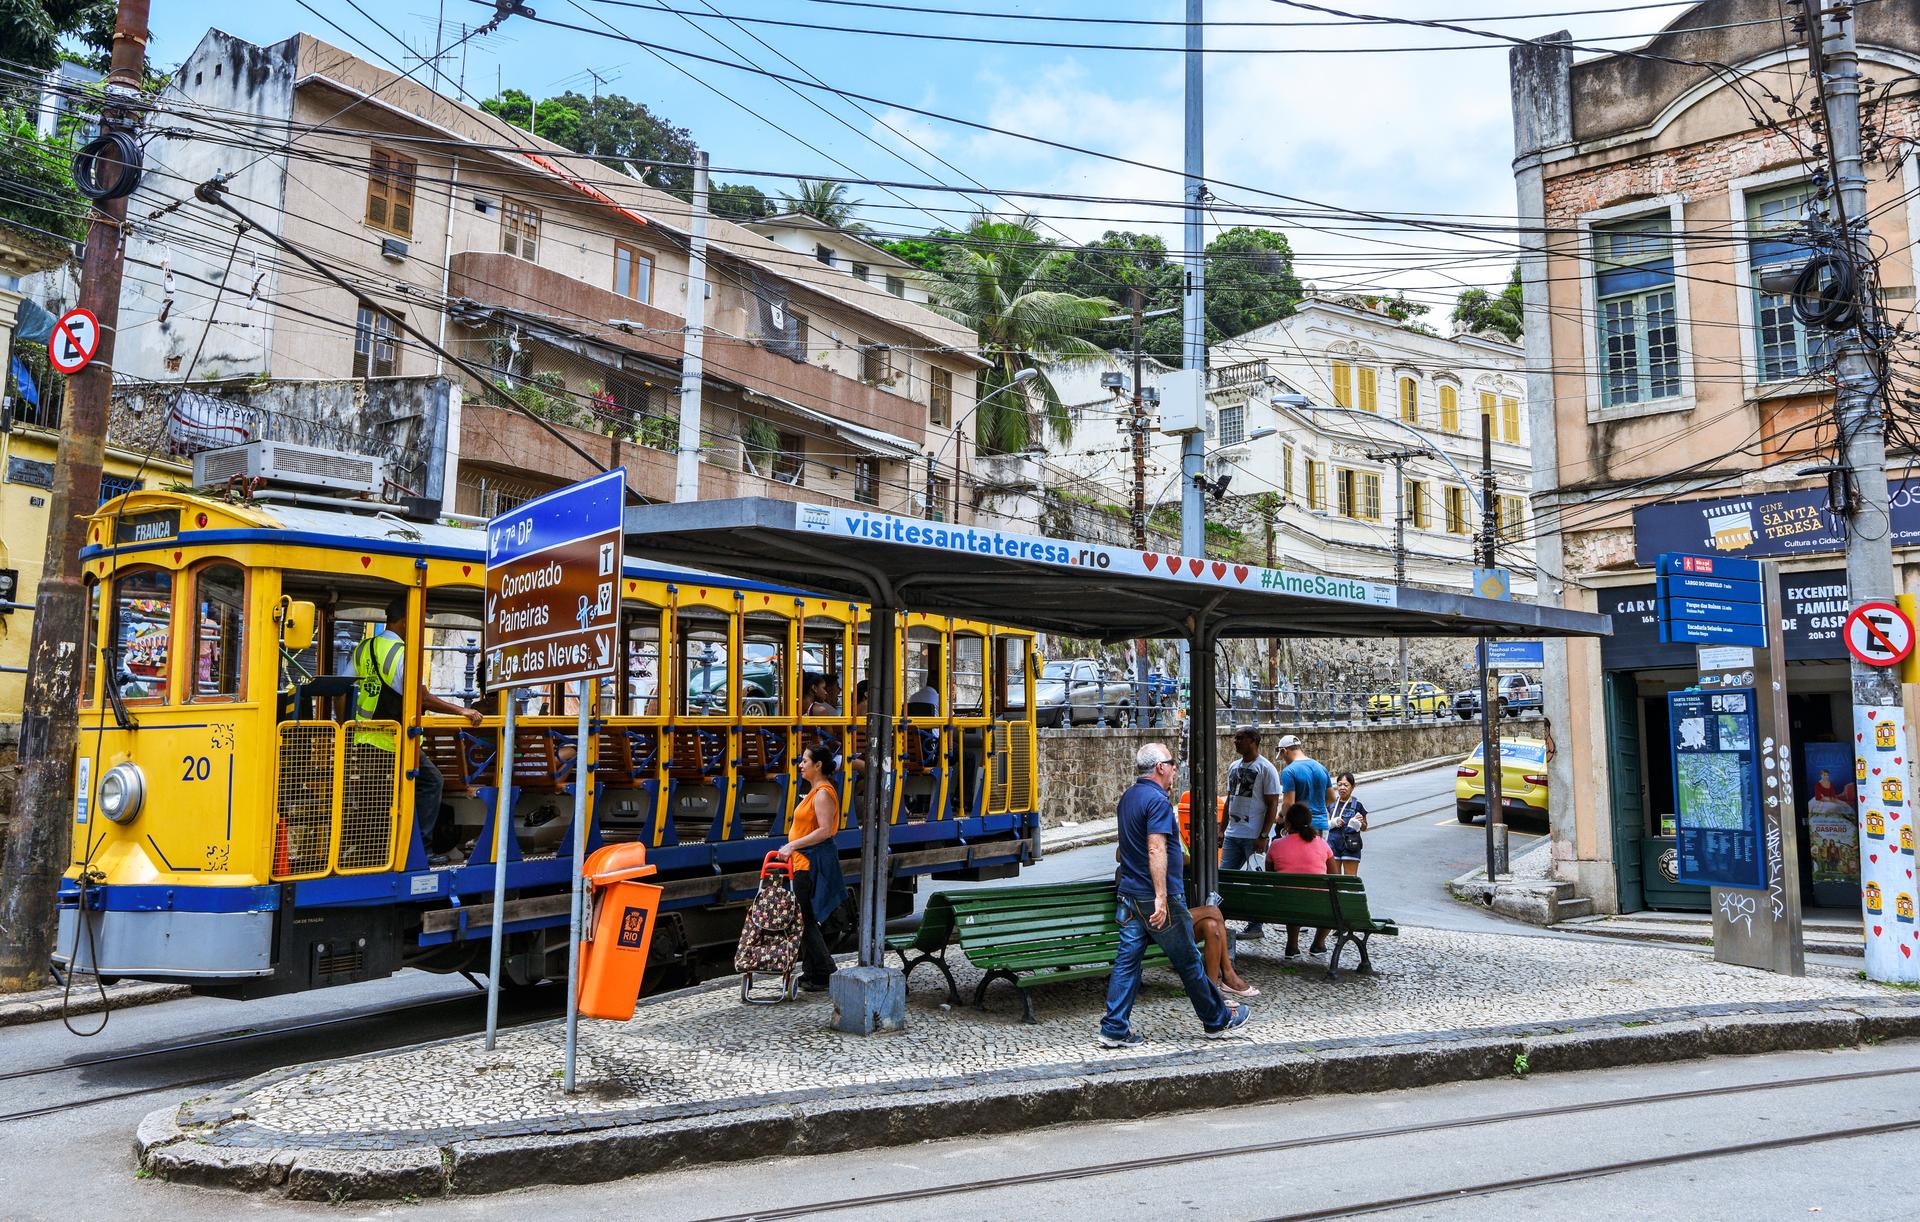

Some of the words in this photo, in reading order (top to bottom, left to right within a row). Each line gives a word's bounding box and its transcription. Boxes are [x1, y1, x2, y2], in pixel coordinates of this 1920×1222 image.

[1759, 501, 1783, 514] CINE
[1762, 506, 1819, 526] SANTA
[517, 517, 533, 546] DP
[1765, 518, 1824, 539] TERESA
[845, 512, 1111, 569] visitesantateresa.rio
[1784, 538, 1811, 548] Cultura
[501, 560, 562, 599] Corcovado
[1261, 569, 1366, 600] #AmeSanta
[1788, 585, 1847, 600] EXCENTRI
[1617, 599, 1656, 614] CARV
[1796, 598, 1849, 615] FAMÍLIA
[499, 603, 549, 634] Paineiras
[1781, 618, 1797, 630] DE
[1810, 616, 1847, 628] GASP
[1808, 631, 1824, 640] 20h
[1824, 630, 1836, 639] 30
[1866, 616, 1892, 652] E
[522, 648, 544, 675] das
[547, 641, 588, 669] Neves
[182, 755, 211, 781] 20
[623, 931, 638, 941] RIO
